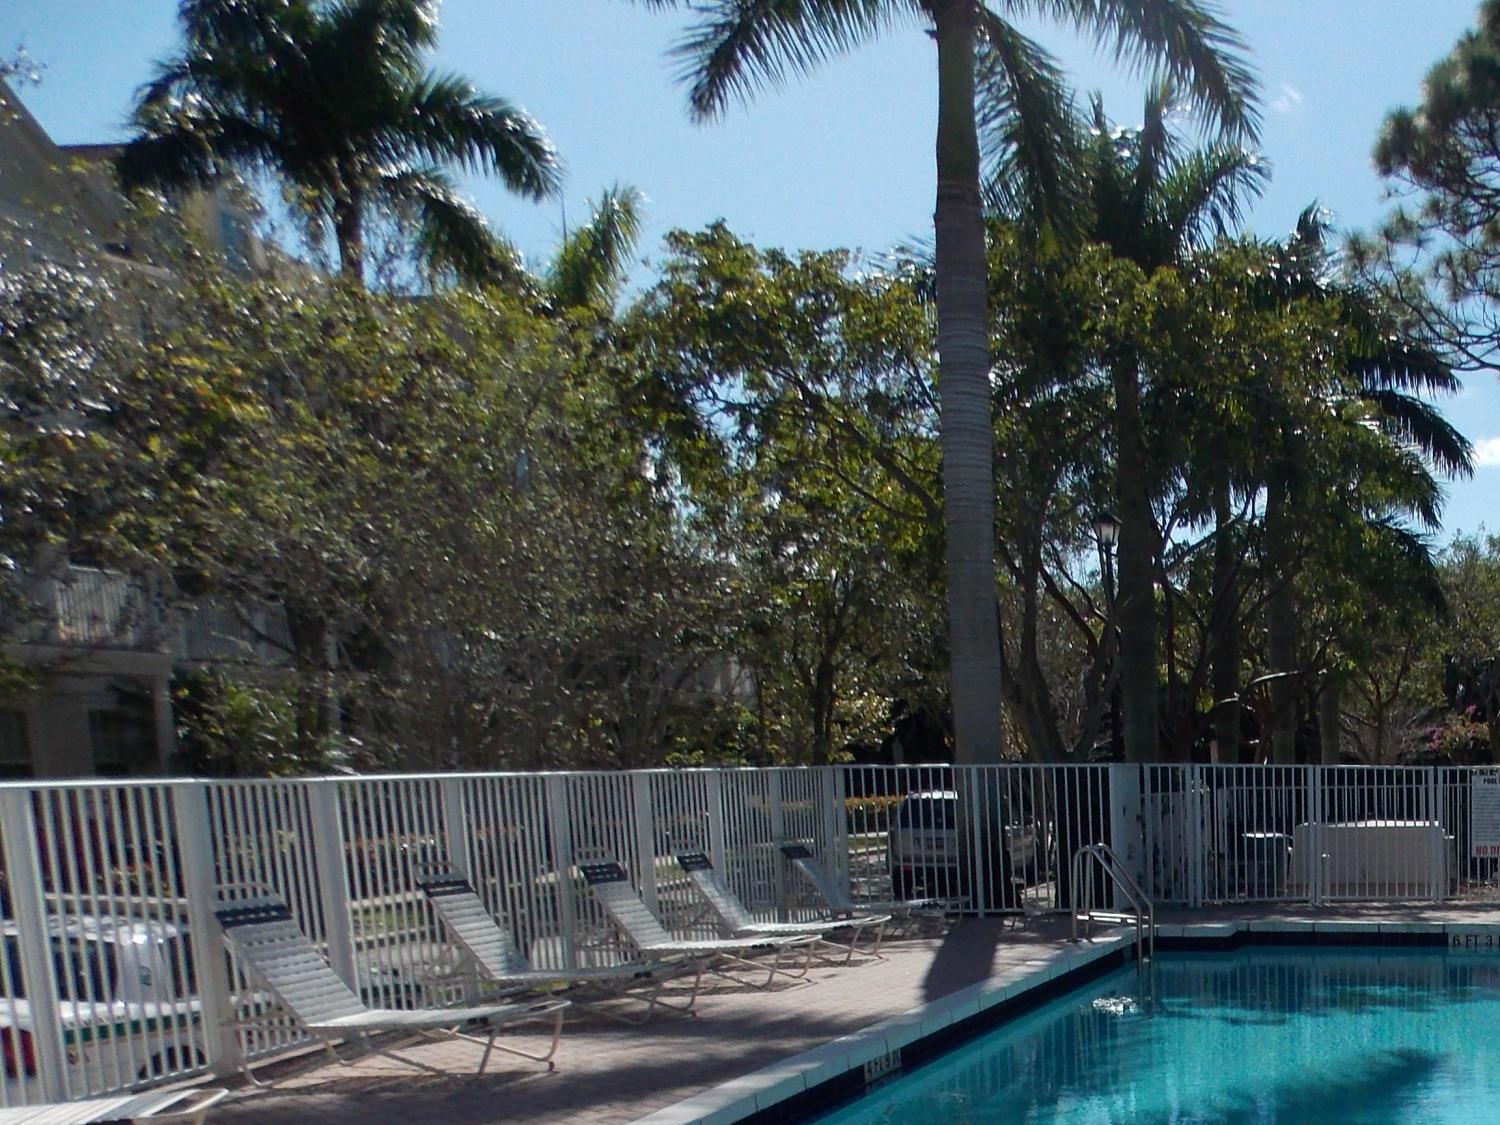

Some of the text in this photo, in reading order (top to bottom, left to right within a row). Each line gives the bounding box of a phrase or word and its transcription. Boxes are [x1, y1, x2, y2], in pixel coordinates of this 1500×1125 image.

[1476, 844, 1488, 855] NO
[1452, 934, 1461, 946] 6
[1465, 934, 1478, 948] FT
[1484, 934, 1493, 946] 3
